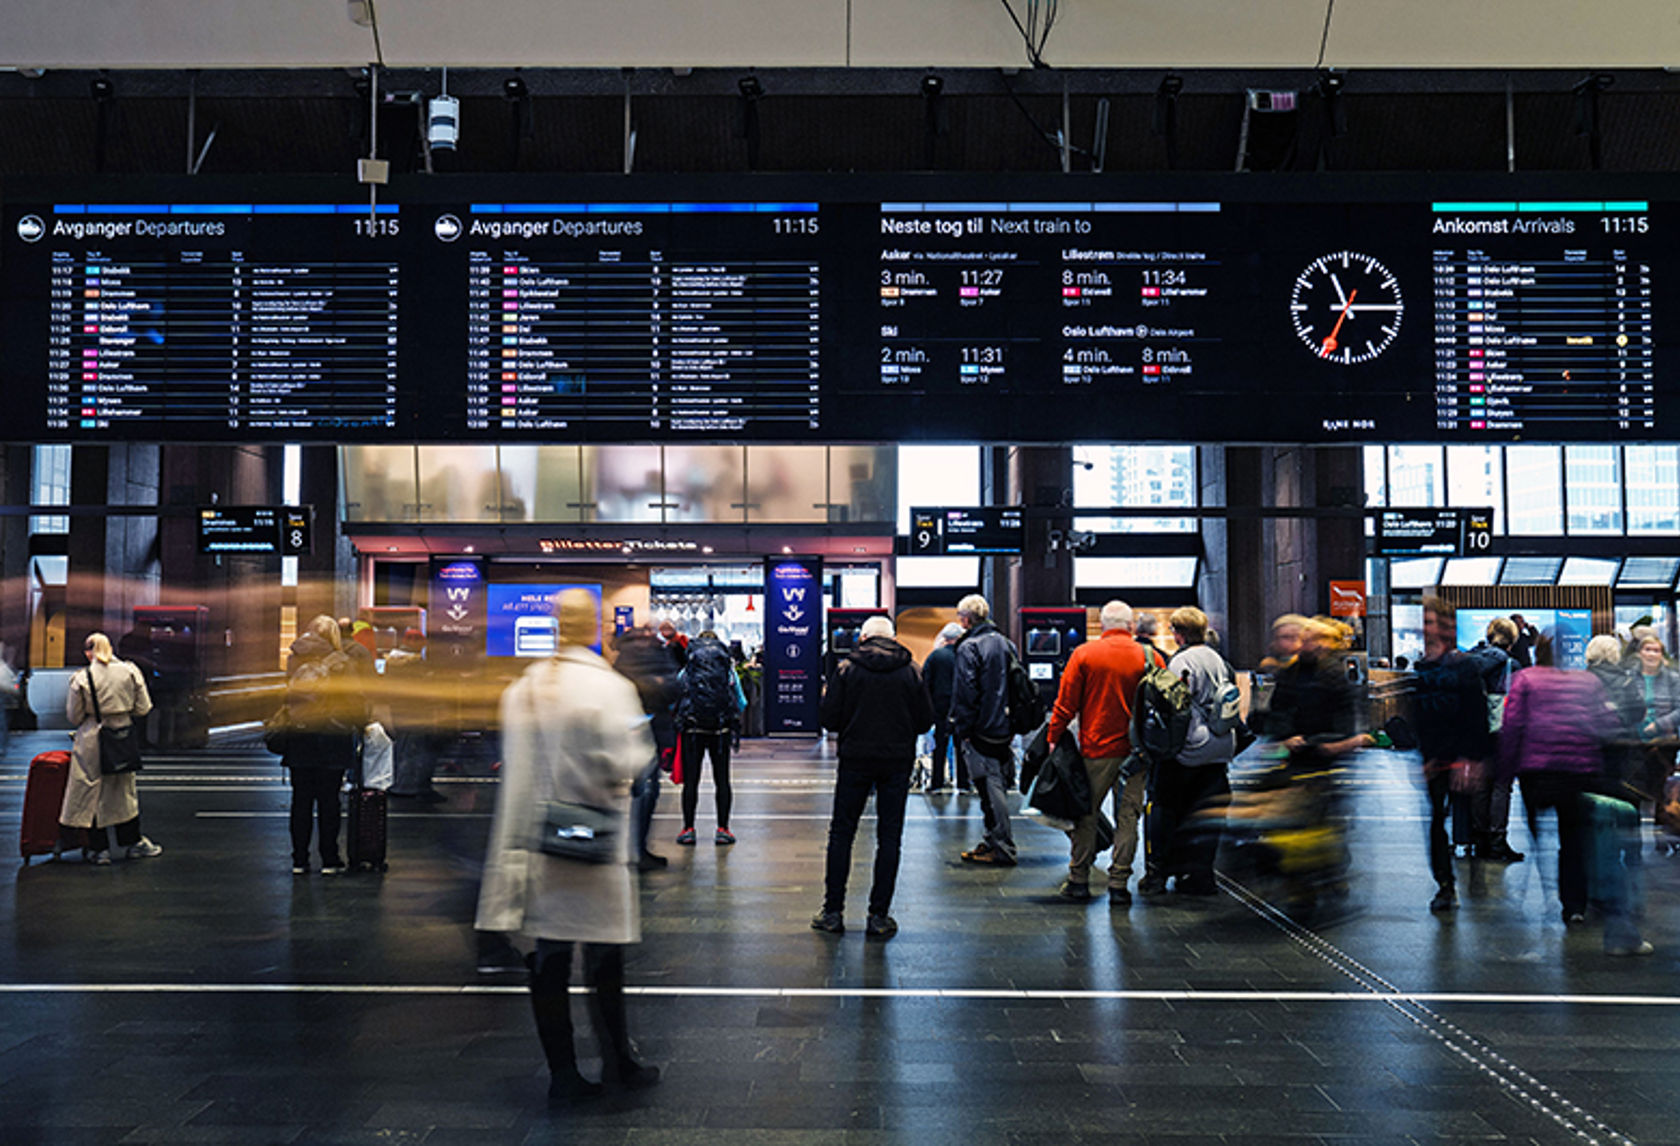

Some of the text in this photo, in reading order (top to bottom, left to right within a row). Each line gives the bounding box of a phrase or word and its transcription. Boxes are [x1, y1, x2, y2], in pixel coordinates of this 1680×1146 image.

[53, 220, 225, 240] Avganger Departures
[470, 219, 643, 239] Avganger Departures
[774, 218, 820, 234] 11:15
[881, 217, 1092, 238] Neste tog til Next train to
[1432, 217, 1576, 234] Ankomst Arrivals
[1600, 216, 1649, 233] 11:15
[881, 249, 910, 260] Asker
[1062, 249, 1114, 260] Lillestrøm
[881, 269, 930, 285] 3 min.
[961, 270, 1003, 285] 11:27
[1062, 269, 1111, 285] 8 min.
[1142, 270, 1186, 285] 11:34
[881, 325, 898, 336] Ski
[1062, 325, 1086, 337] Oslo
[1088, 325, 1134, 337] Lufthavn
[881, 347, 930, 362] 2 min.
[961, 347, 1002, 362] 11:31
[1063, 347, 1112, 362] 4 min.
[1142, 347, 1192, 362] 8 min.
[290, 530, 302, 548] 8
[540, 540, 696, 550] Billetter Tickets
[918, 530, 930, 548] 9
[1468, 532, 1490, 548] 10
